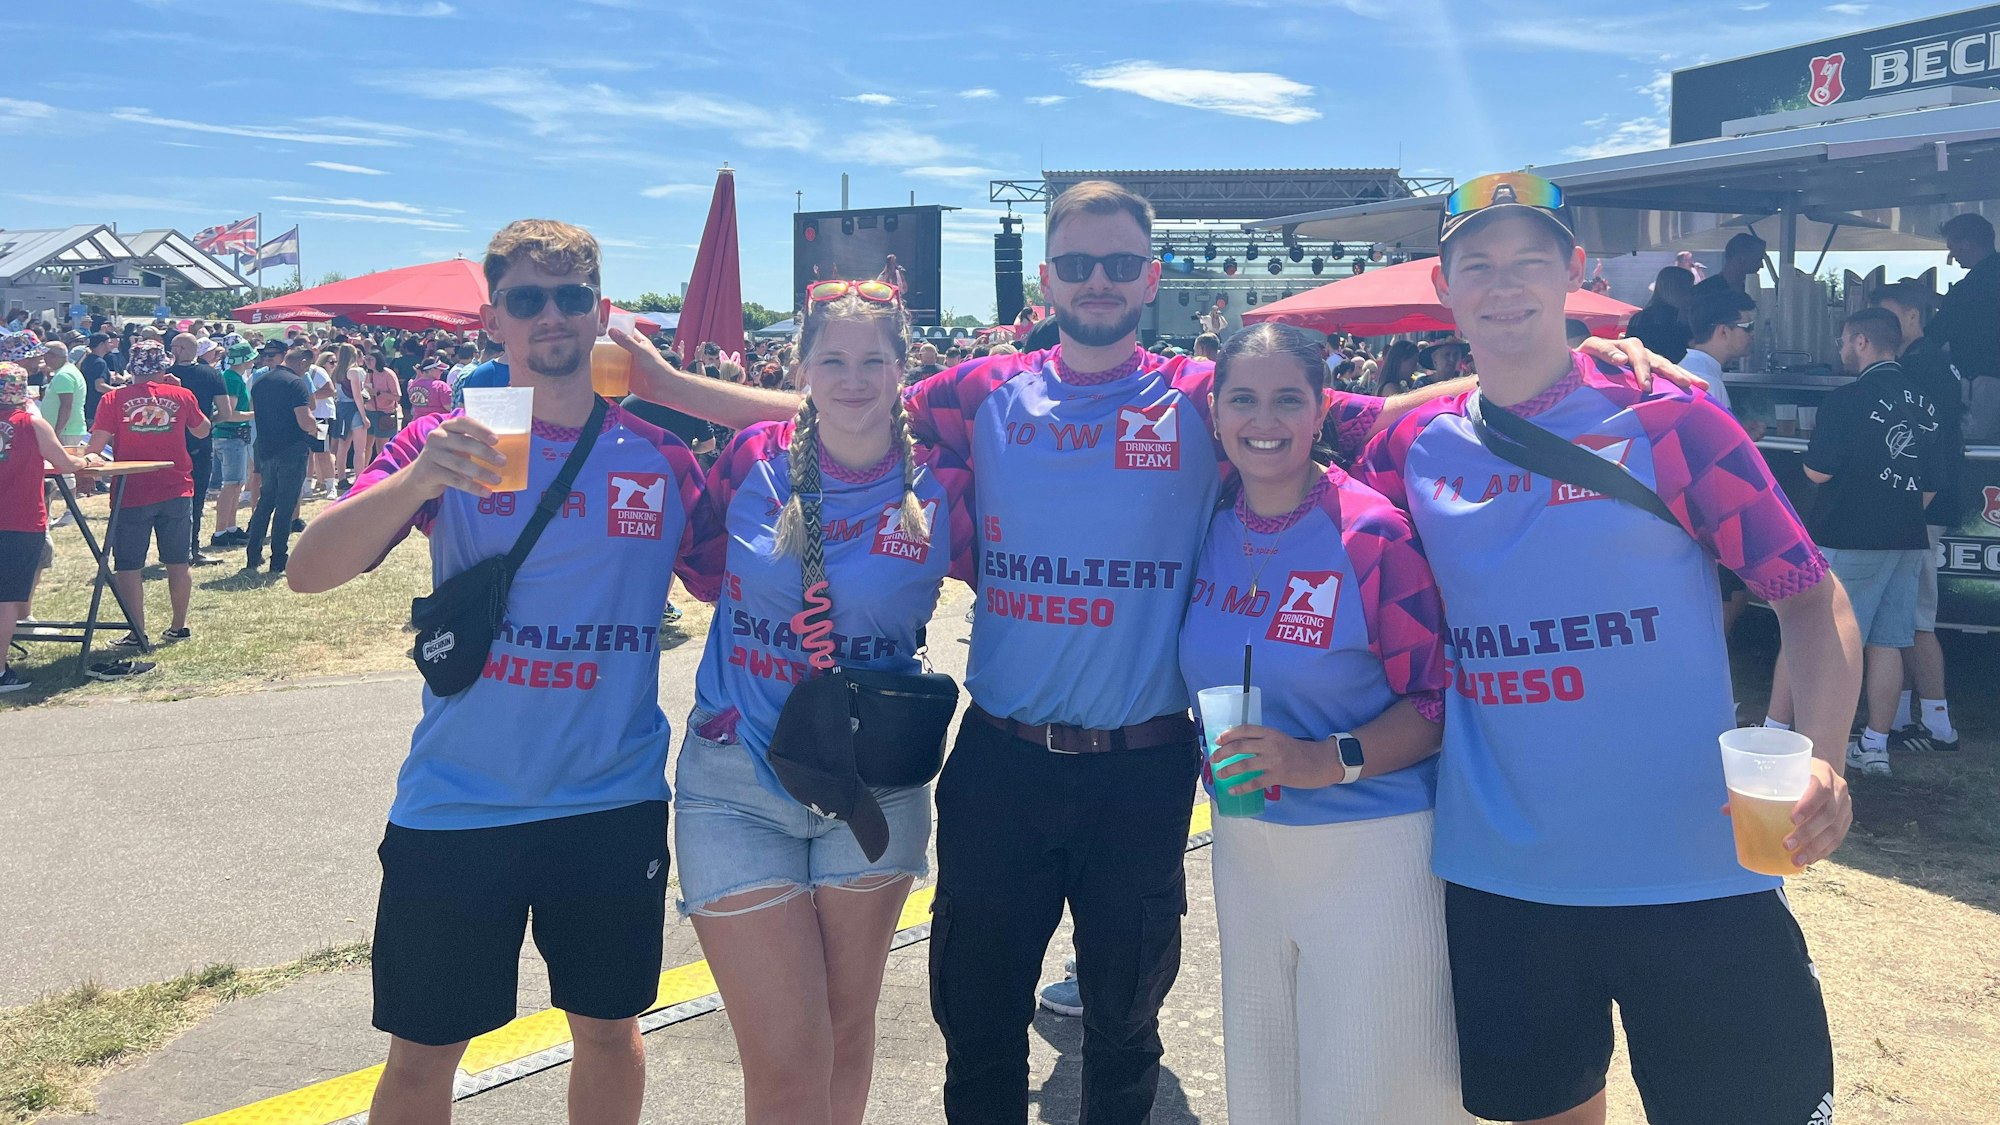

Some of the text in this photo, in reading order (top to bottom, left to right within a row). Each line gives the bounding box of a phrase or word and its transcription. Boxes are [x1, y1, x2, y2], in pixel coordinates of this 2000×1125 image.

[1870, 390, 1939, 432] FLRID
[1006, 421, 1103, 451] 10 YW
[1125, 442, 1172, 452] DRINKING
[1125, 453, 1172, 468] TEAM
[1880, 467, 1921, 491] STA
[478, 491, 516, 516] 89
[1558, 483, 1600, 501] TEA
[617, 510, 657, 521] DRINKING
[618, 520, 657, 537] TEAM
[984, 514, 1002, 543] ES
[882, 540, 922, 560] TEAM
[1936, 542, 2000, 571] EC
[985, 550, 1183, 589] ESKALIERT
[987, 586, 1115, 627] SOWIESO
[1221, 585, 1271, 618] MD
[1280, 613, 1324, 628] DRINKING
[1276, 624, 1322, 645] TEAM
[1444, 607, 1660, 660] KALIERT
[482, 652, 598, 690] WIESO
